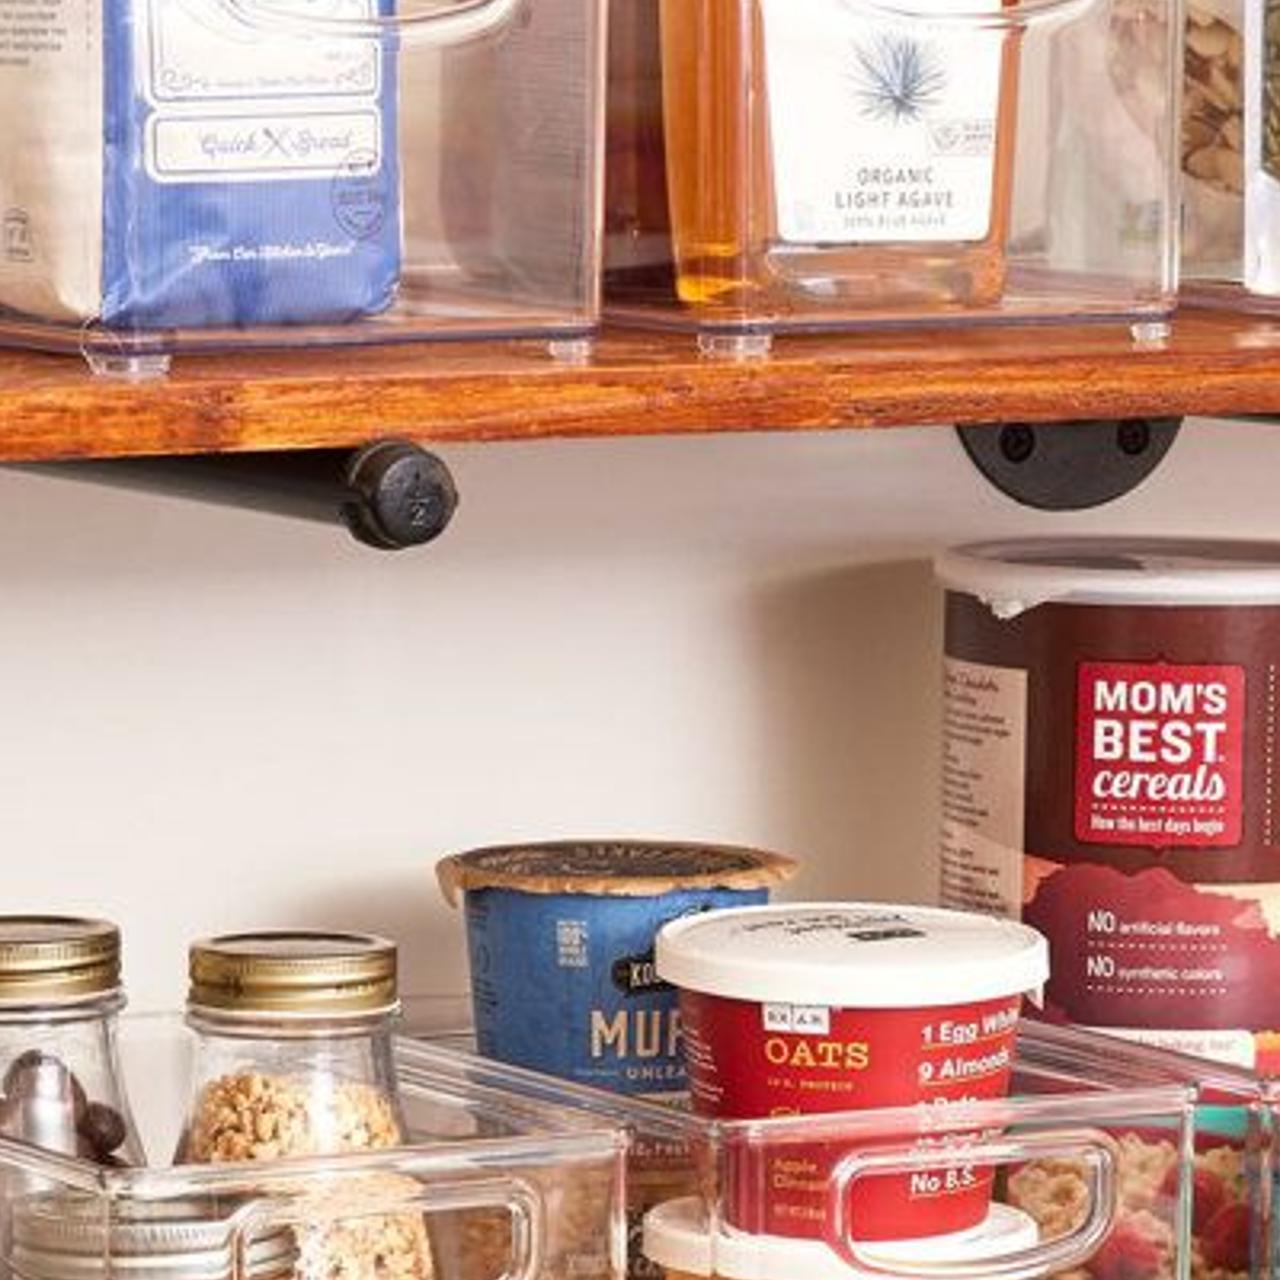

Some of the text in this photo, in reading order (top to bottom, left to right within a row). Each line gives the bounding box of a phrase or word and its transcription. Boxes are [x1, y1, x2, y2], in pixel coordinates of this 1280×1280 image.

[1093, 680, 1228, 716] MOM'S
[1093, 719, 1227, 764] BEST
[1092, 764, 1226, 802] cereals
[1087, 912, 1115, 933] NO
[1087, 956, 1115, 977] NO
[939, 1018, 978, 1045] Egg
[764, 1038, 870, 1070] OATS
[910, 1173, 940, 1193] No
